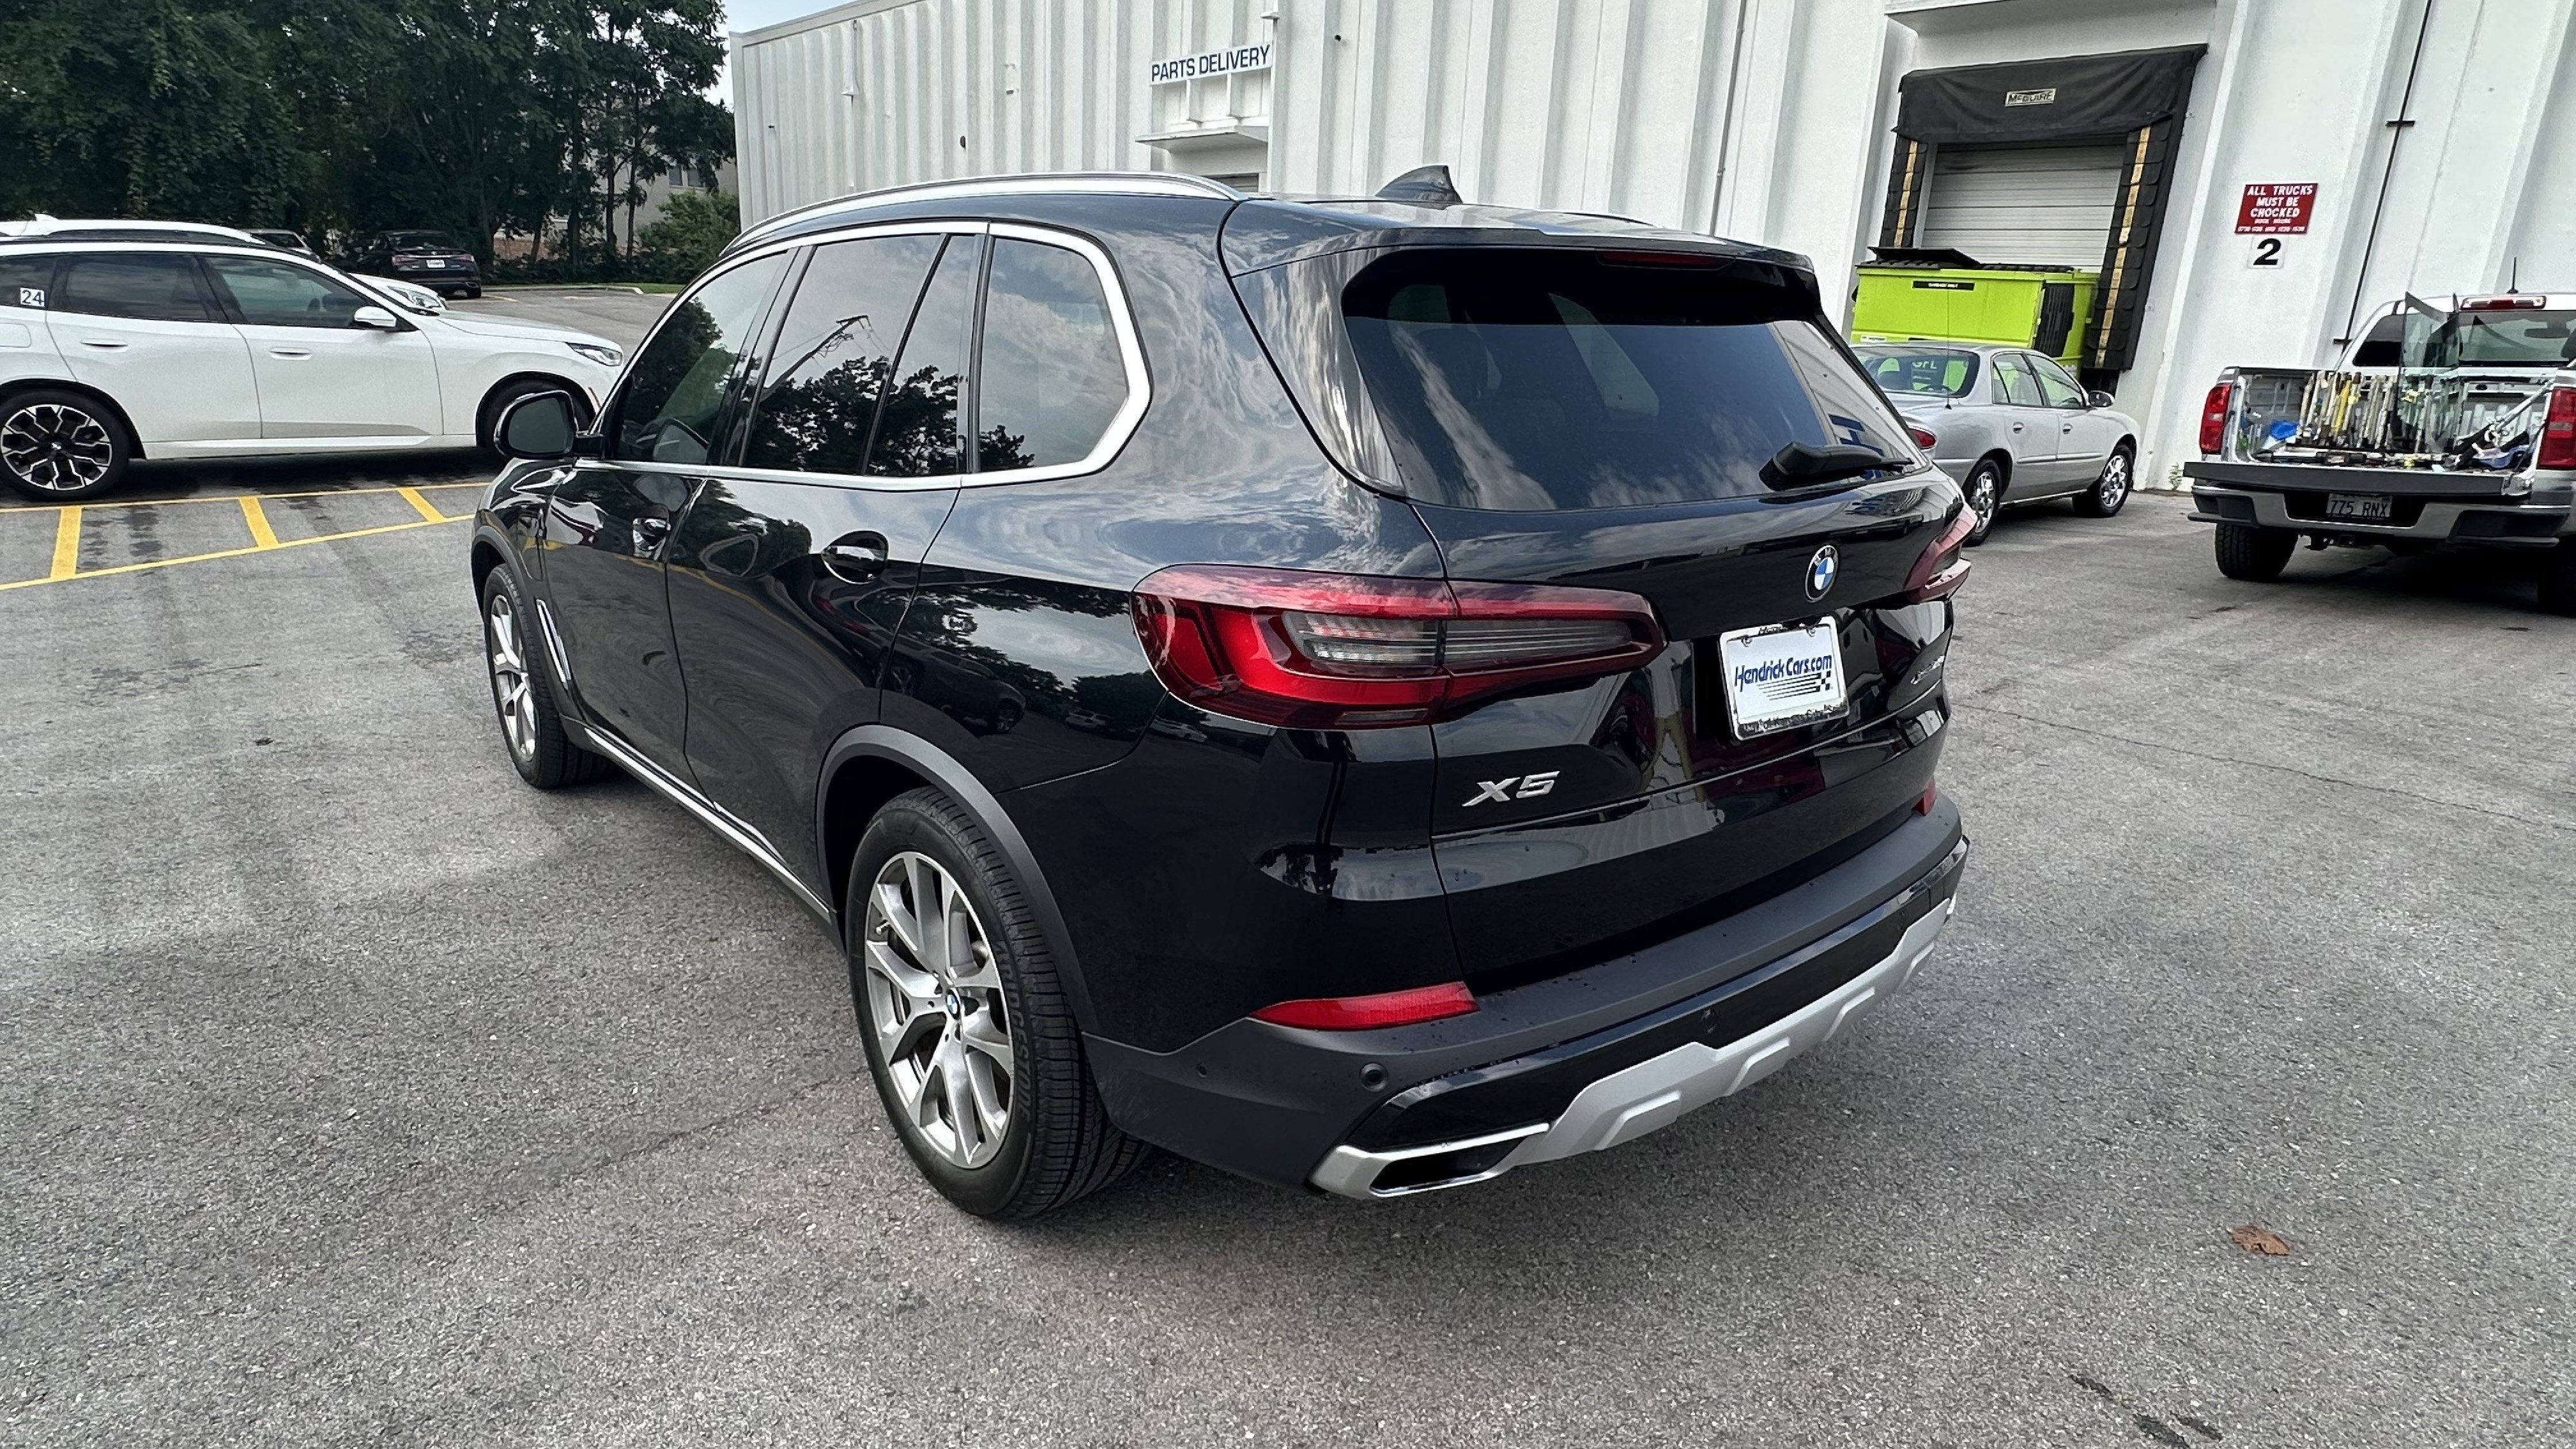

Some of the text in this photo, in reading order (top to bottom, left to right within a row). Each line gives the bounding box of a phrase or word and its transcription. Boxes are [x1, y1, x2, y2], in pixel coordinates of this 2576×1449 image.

[1151, 44, 1270, 82] PARTS DELIVERY
[2247, 185, 2313, 195] ALL TRUCKS
[2256, 197, 2300, 206] MUST BE
[2250, 208, 2300, 217] CHOCKED
[2253, 238, 2281, 266] 2
[22, 289, 44, 305] 24
[2331, 500, 2388, 517] 775 RNX
[1462, 770, 1560, 807] X5
